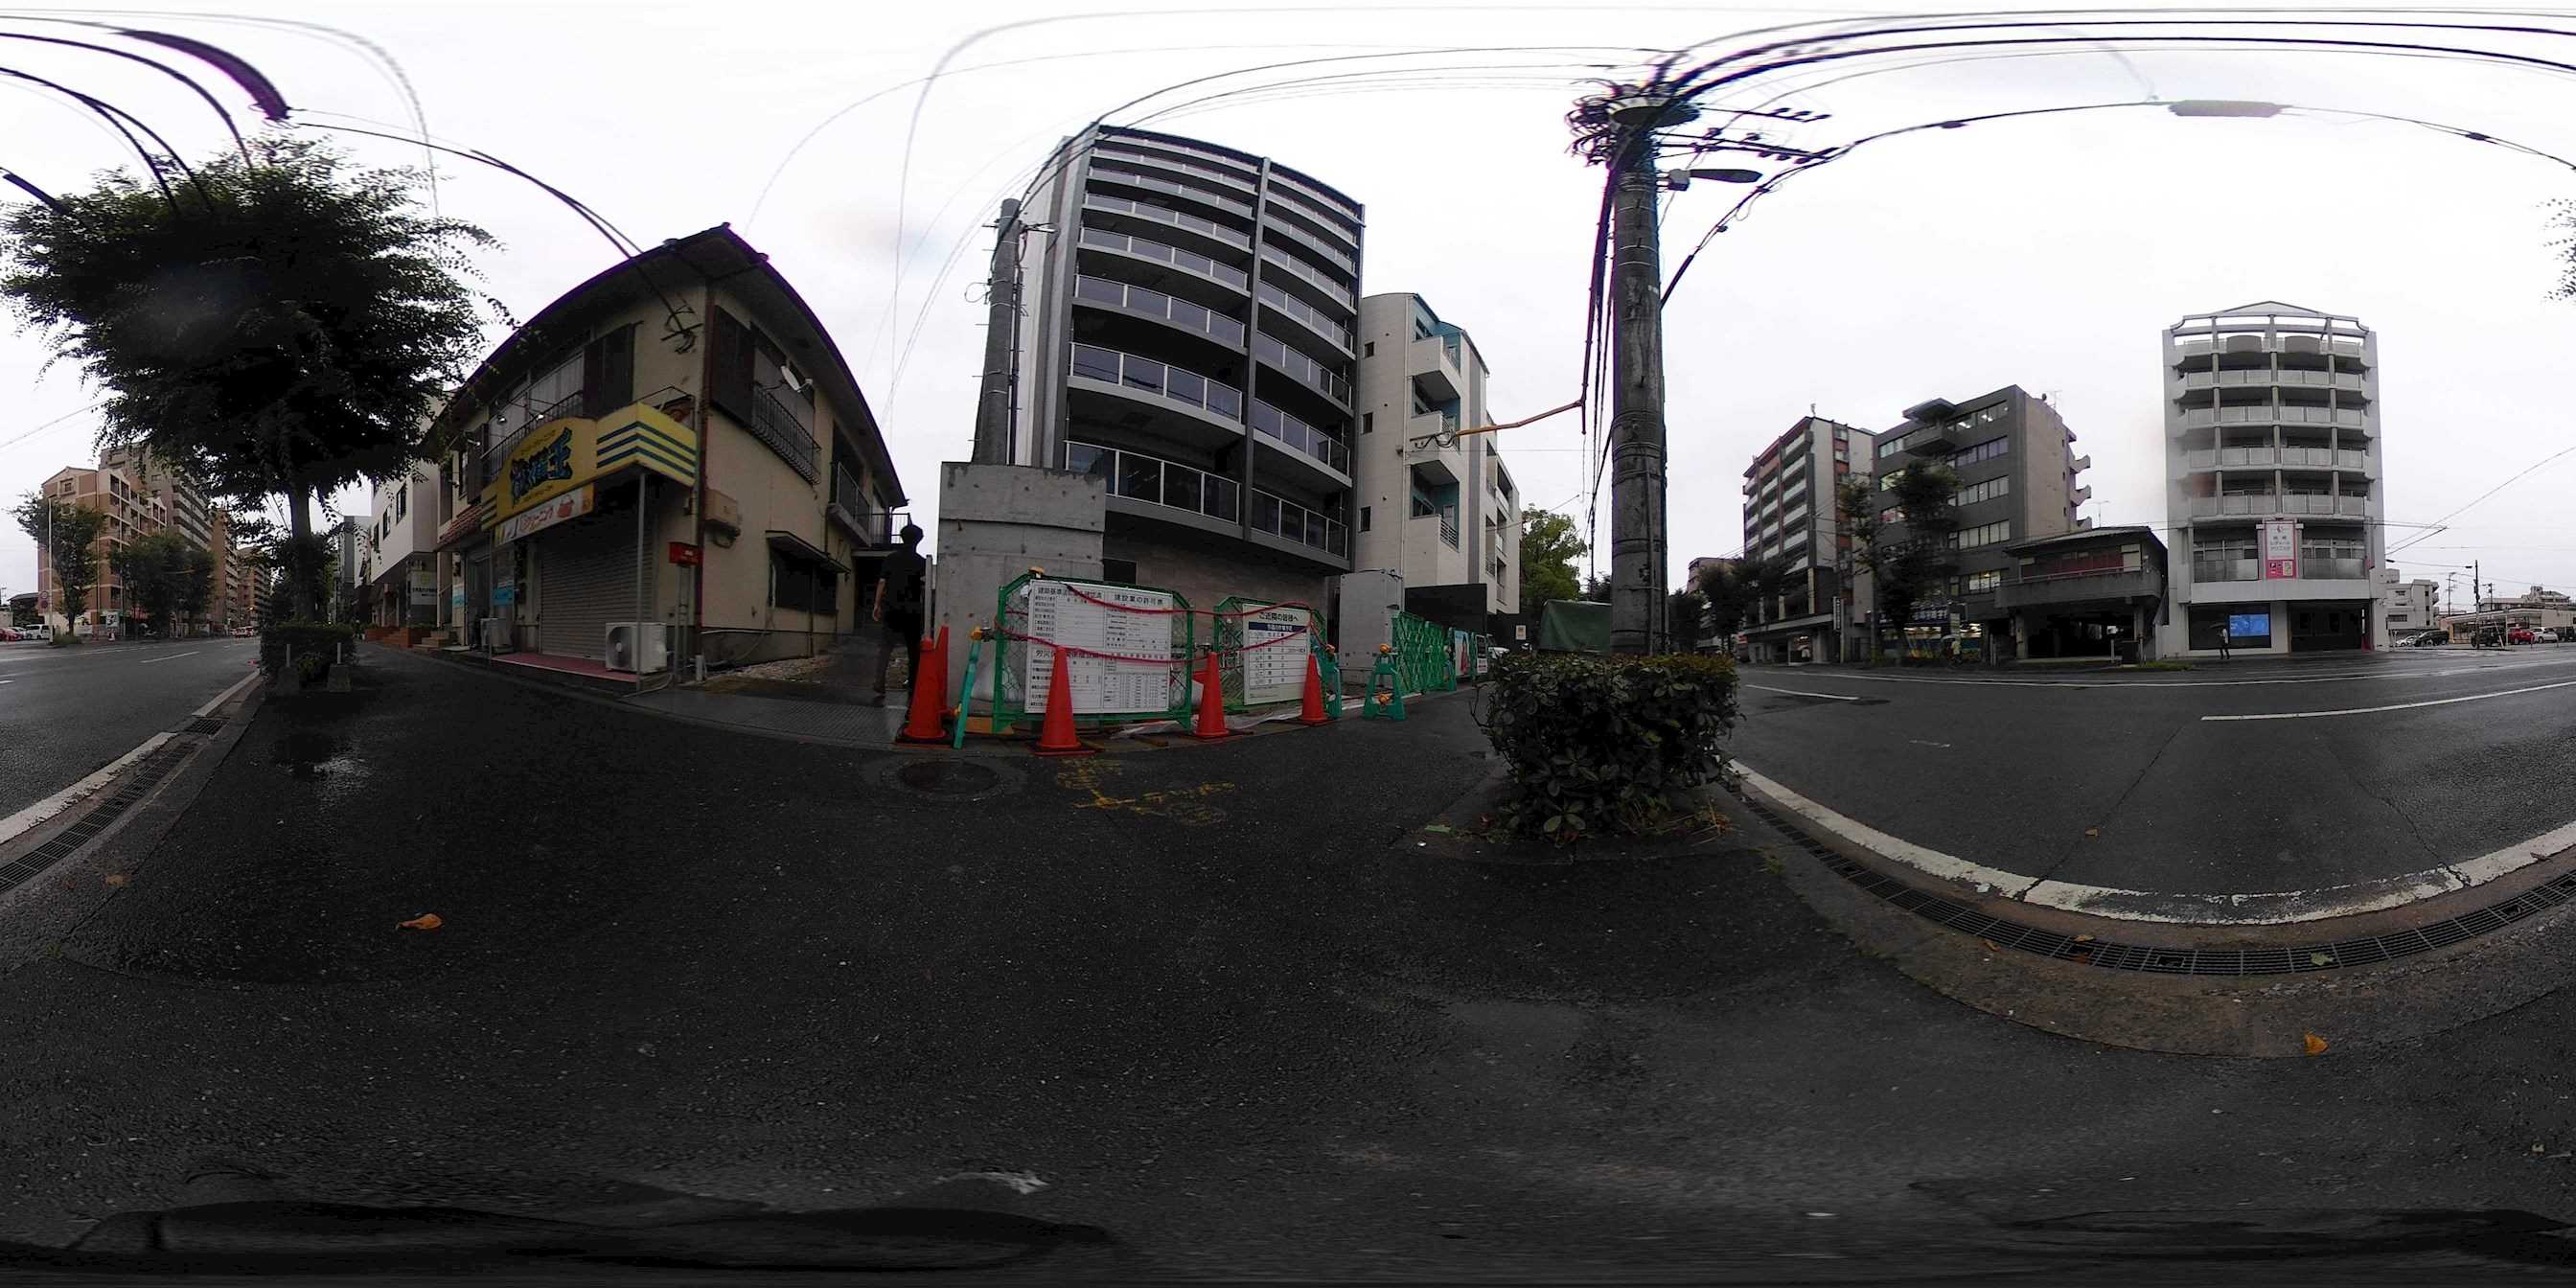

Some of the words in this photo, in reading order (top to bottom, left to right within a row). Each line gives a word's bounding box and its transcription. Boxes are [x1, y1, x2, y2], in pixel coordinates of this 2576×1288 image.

[1258, 612, 1300, 622] ご近隣の皆様へ
